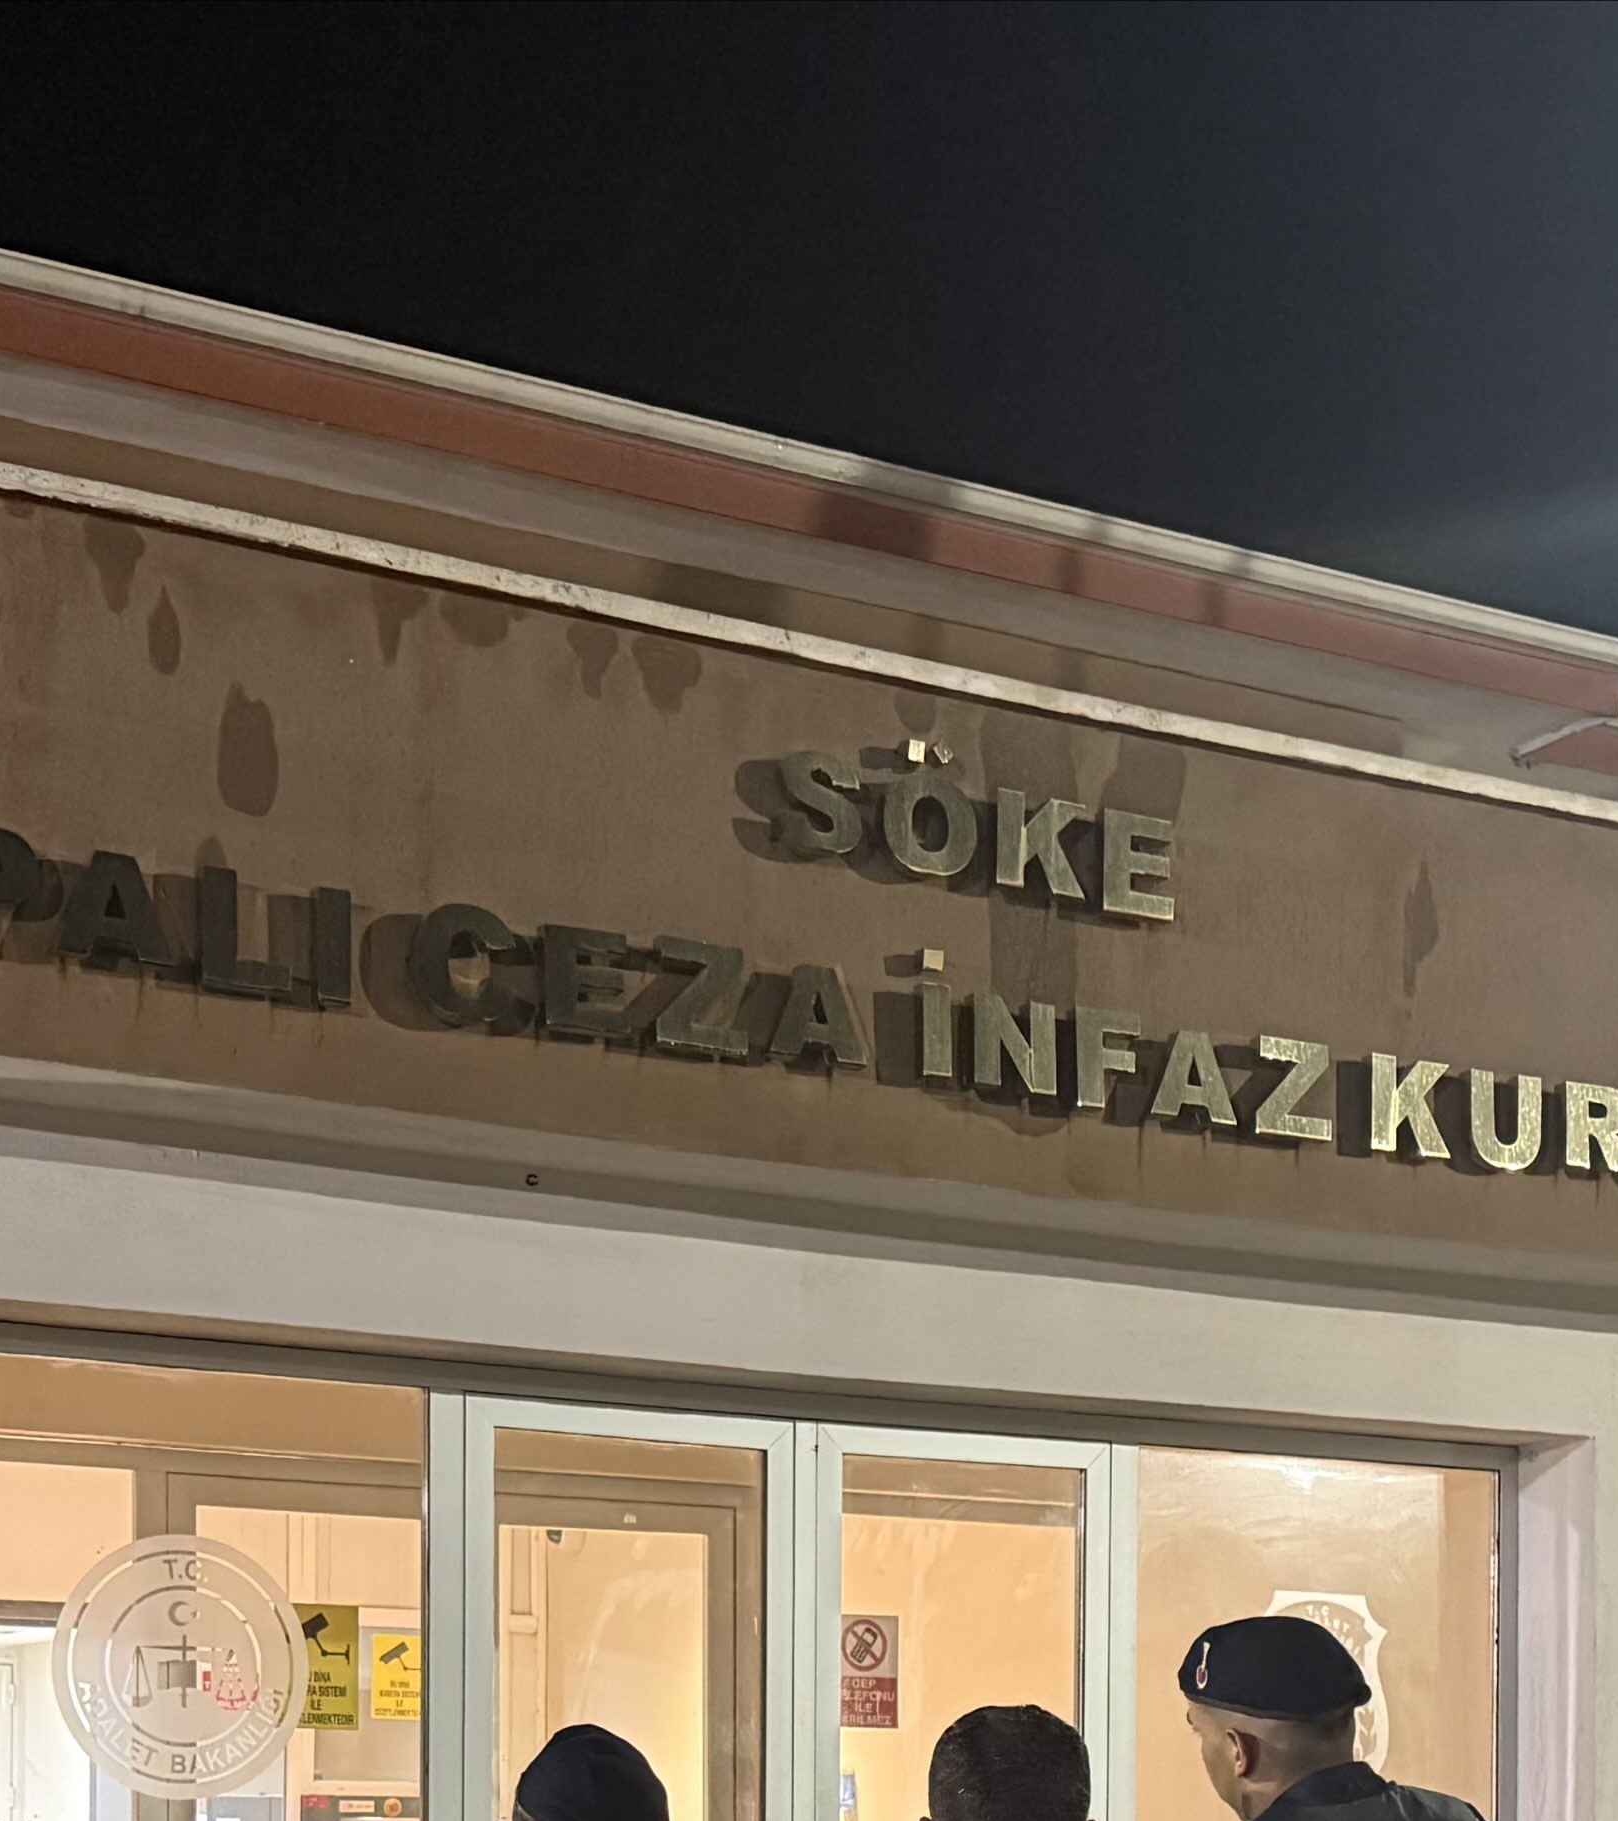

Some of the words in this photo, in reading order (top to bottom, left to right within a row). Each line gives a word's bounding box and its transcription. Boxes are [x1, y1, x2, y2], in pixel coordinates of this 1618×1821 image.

[770, 737, 1176, 921] SÖKE
[405, 902, 869, 1070] CEZA
[921, 946, 1334, 1142] İNFAZ
